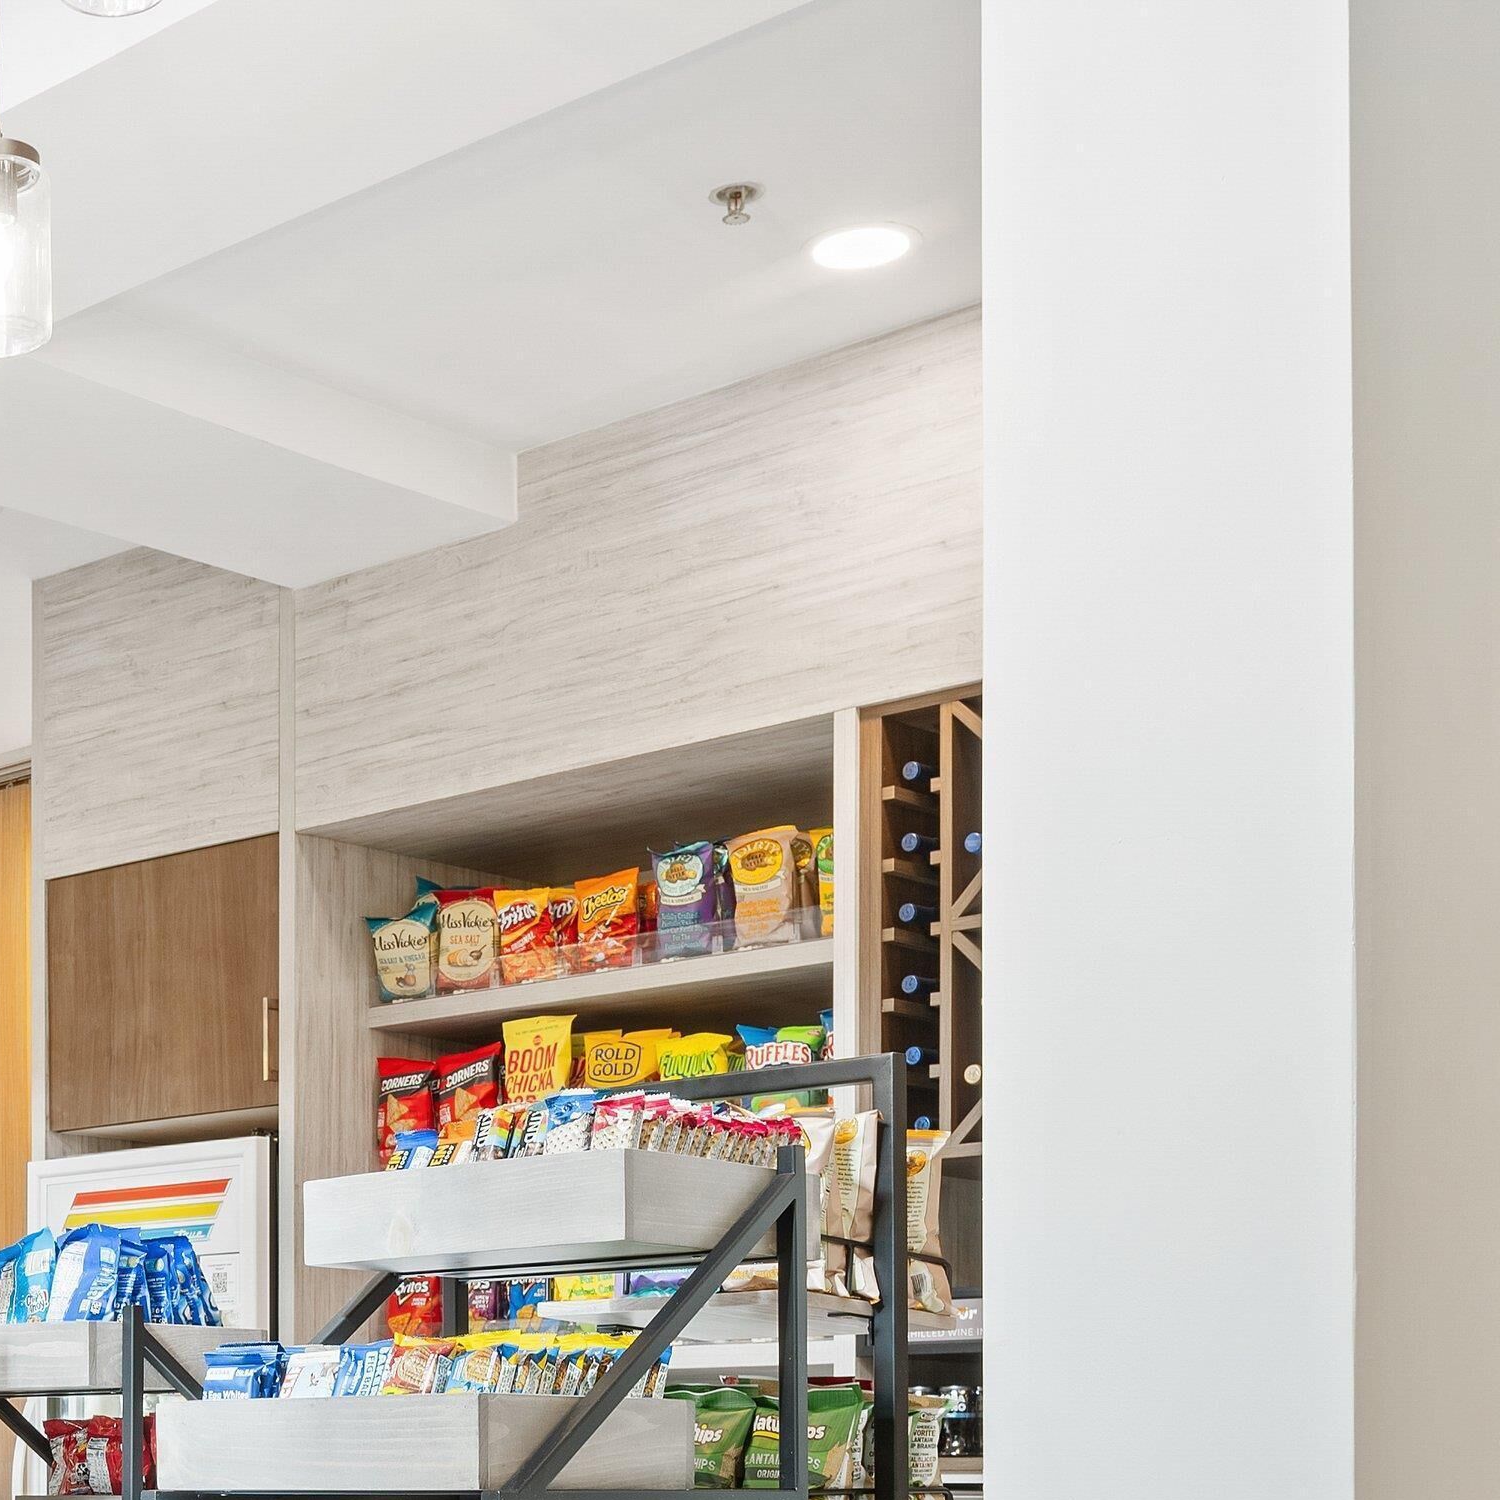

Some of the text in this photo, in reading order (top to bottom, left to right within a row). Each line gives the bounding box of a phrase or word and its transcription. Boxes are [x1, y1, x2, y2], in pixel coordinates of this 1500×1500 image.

[581, 885, 627, 922] Cheetos
[449, 935, 480, 945] SEA SALT
[508, 1042, 558, 1073] BOOM
[595, 1047, 636, 1062] ROLD
[746, 1042, 812, 1070] RUFFLES
[445, 1058, 490, 1088] CORNERS
[592, 1061, 635, 1077] GOLD
[381, 1073, 424, 1092] CORNERS
[505, 1069, 555, 1094] CHICKA
[908, 1330, 945, 1339] HILLED
[947, 1327, 973, 1337] WINE
[366, 1355, 376, 1374] FIG
[222, 1389, 249, 1400] Whites
[694, 1458, 716, 1471] HIPS
